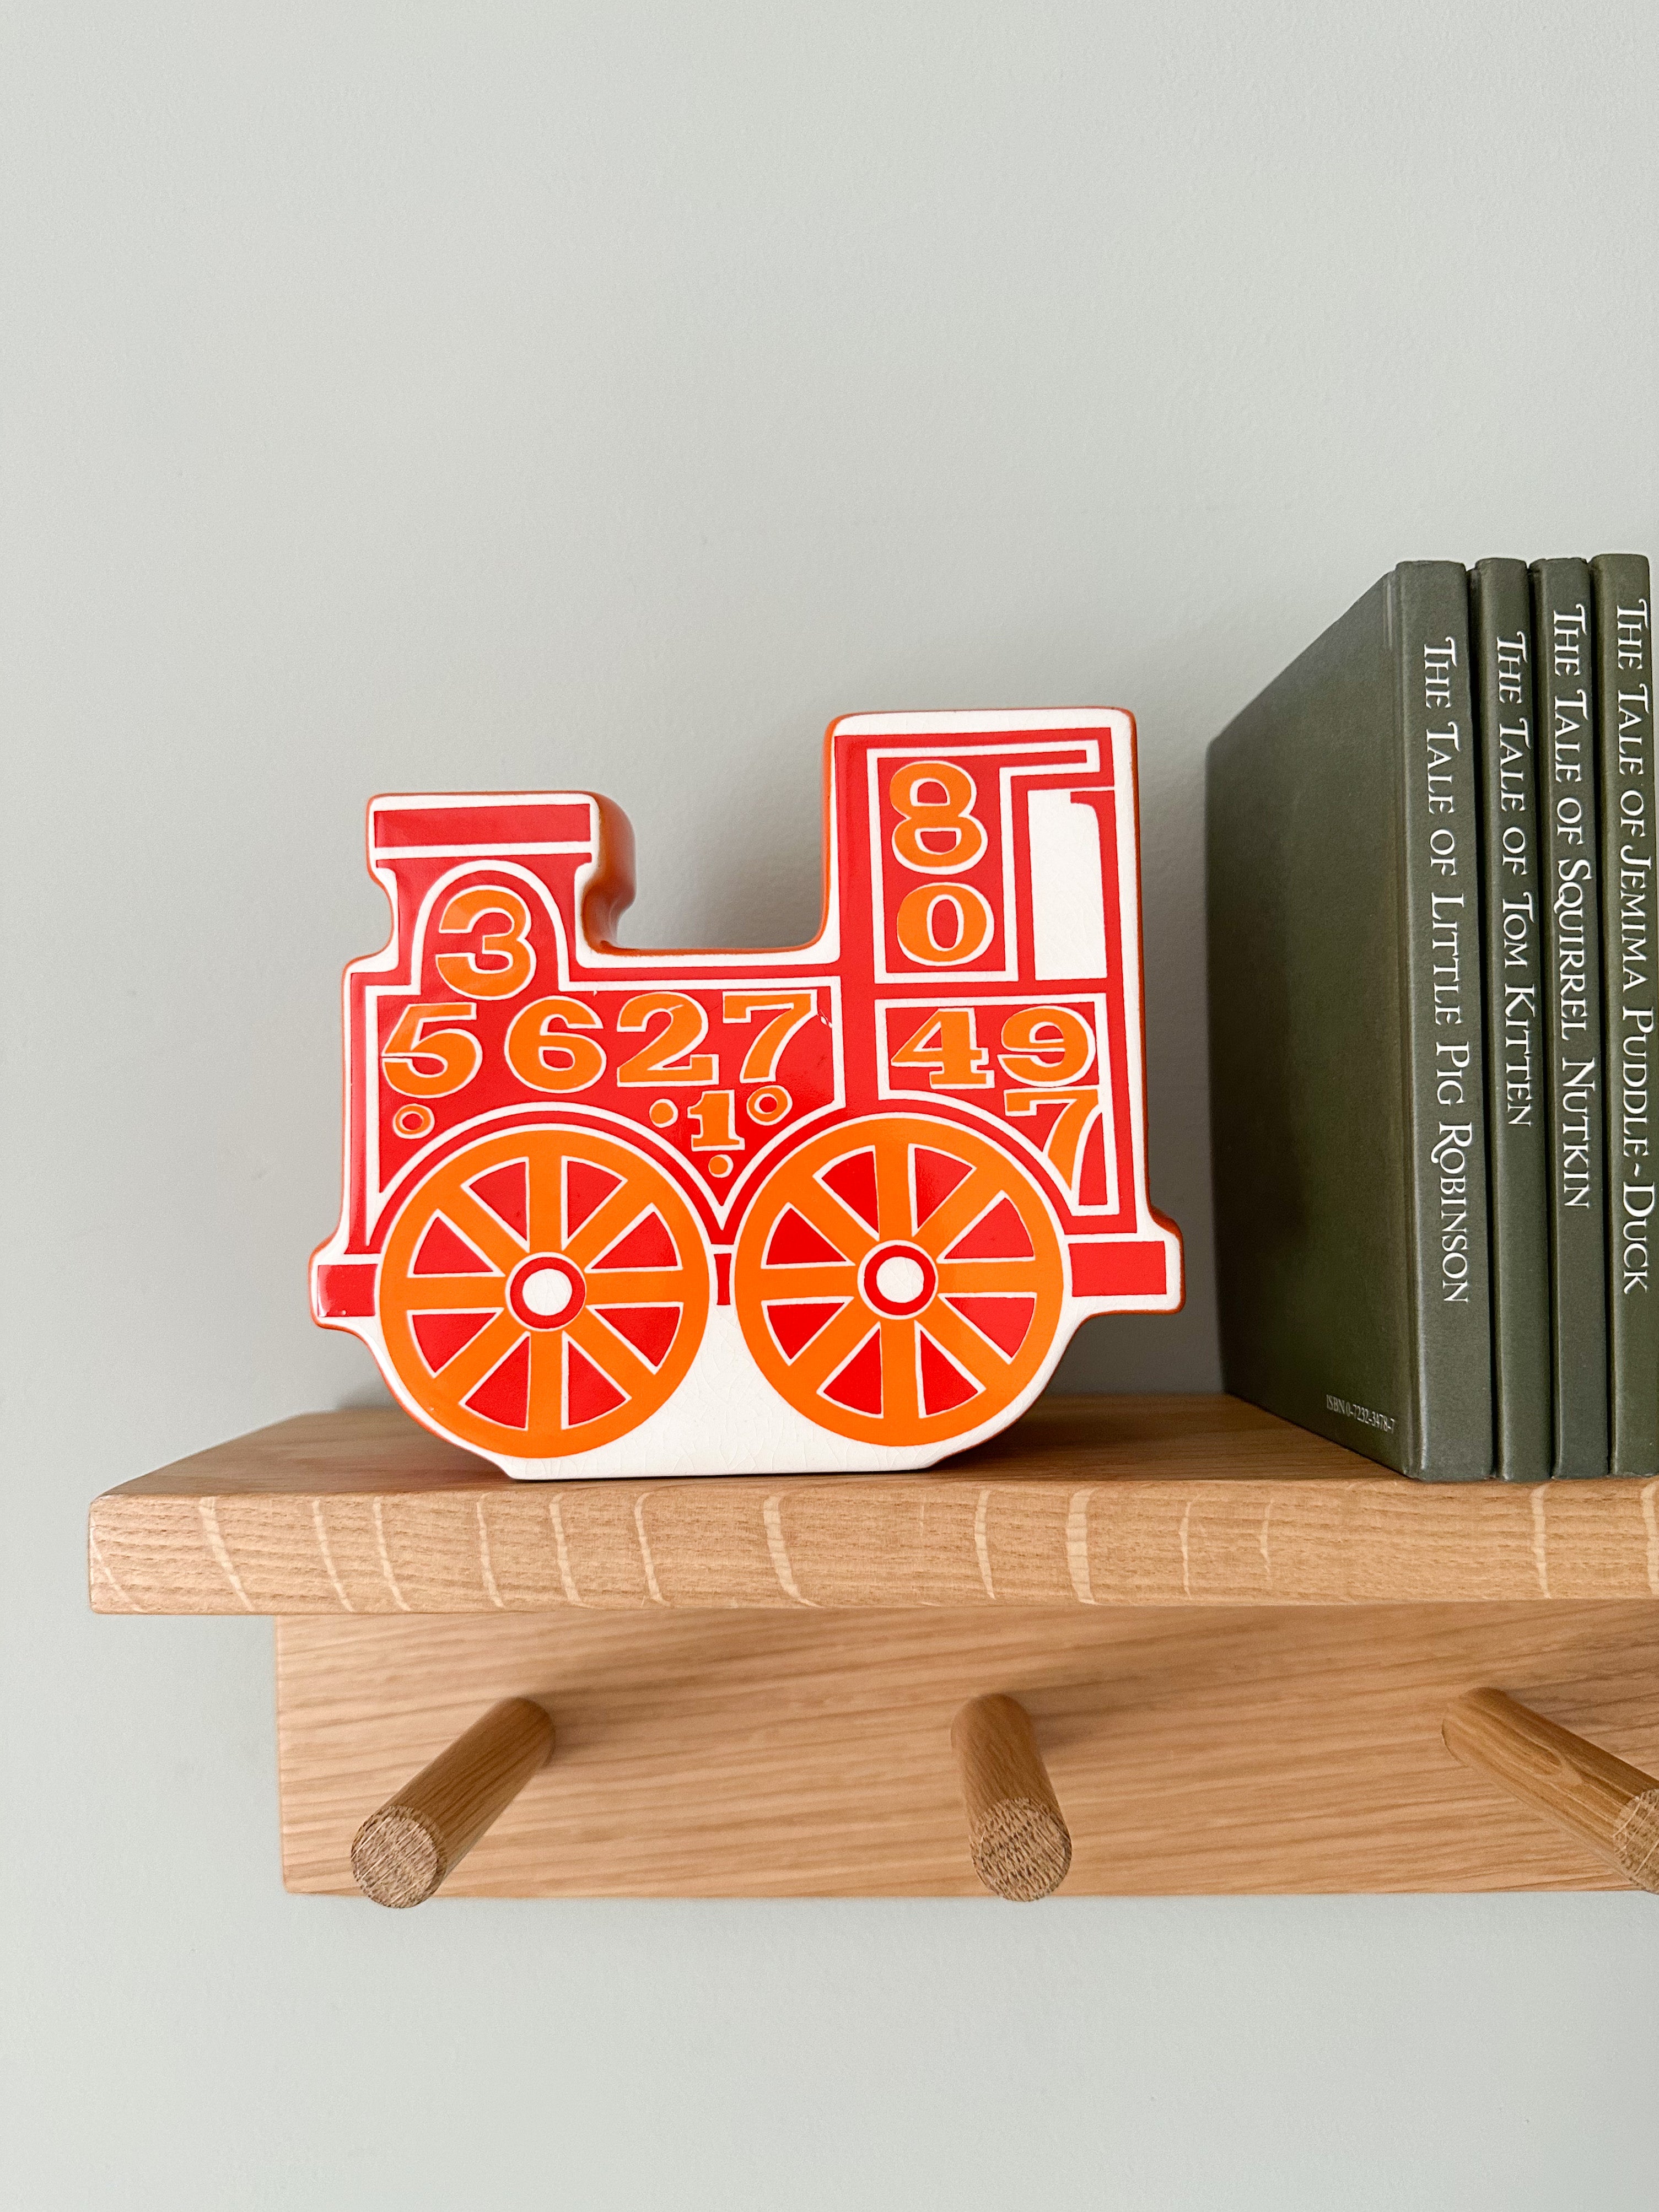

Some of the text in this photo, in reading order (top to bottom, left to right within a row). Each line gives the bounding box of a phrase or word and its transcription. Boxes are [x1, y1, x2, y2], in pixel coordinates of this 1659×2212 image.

[1616, 598, 1648, 670] THE
[1617, 683, 1650, 775] TALE
[886, 759, 989, 875] 8
[1619, 790, 1646, 845] OF
[895, 882, 994, 967] 0
[1496, 630, 1536, 1126] THE TALE OF TOM KITTEN
[1553, 603, 1596, 1208] THE TALE OF SQUIRREL NUTKIN
[1619, 844, 1652, 992] JEMIMA
[434, 886, 534, 1000] 3
[1423, 636, 1473, 1303] THE TALE OF LITTLE PIG ROBINSON
[688, 1091, 744, 1152] 1
[1004, 1086, 1102, 1194] 7
[1326, 1394, 1396, 1434] ISBN 0-7232-3478-7
